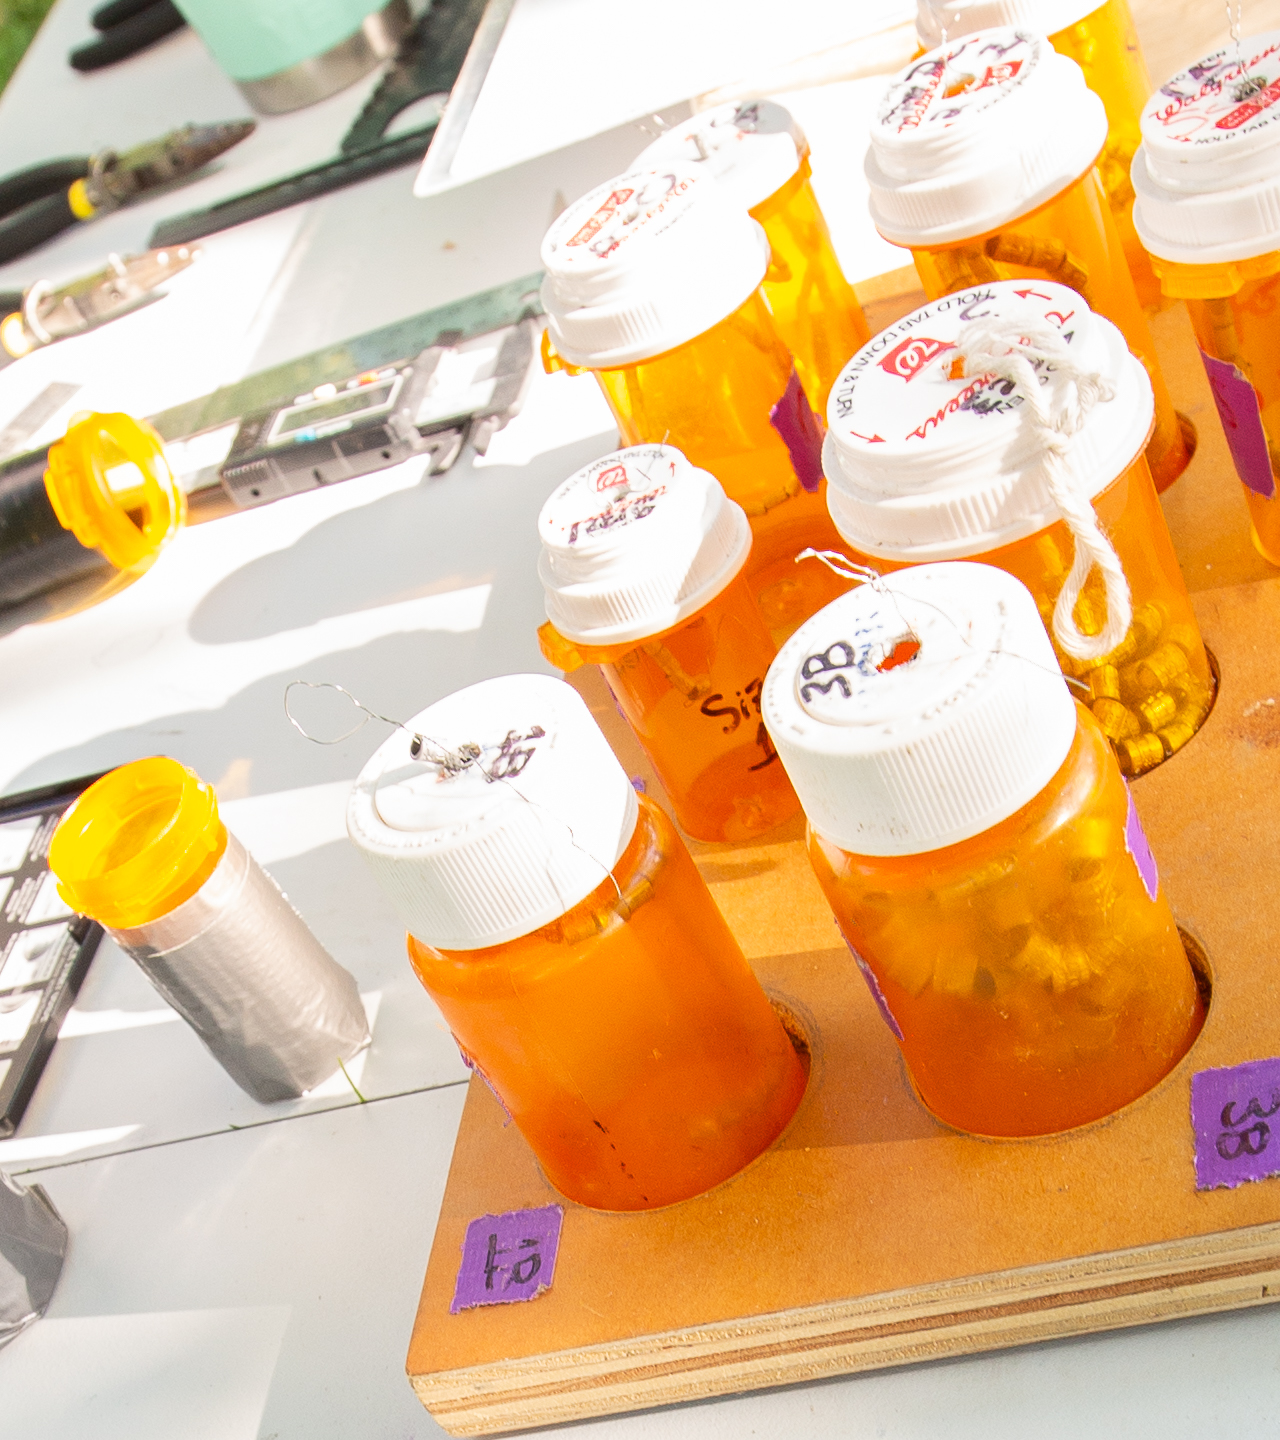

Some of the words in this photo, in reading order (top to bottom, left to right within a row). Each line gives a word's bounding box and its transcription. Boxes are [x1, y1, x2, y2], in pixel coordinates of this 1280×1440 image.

[937, 288, 997, 312] HOLD
[898, 313, 934, 331] TAB
[858, 332, 898, 375] DOWN
[836, 383, 855, 419] TURN
[800, 640, 857, 705] 3B
